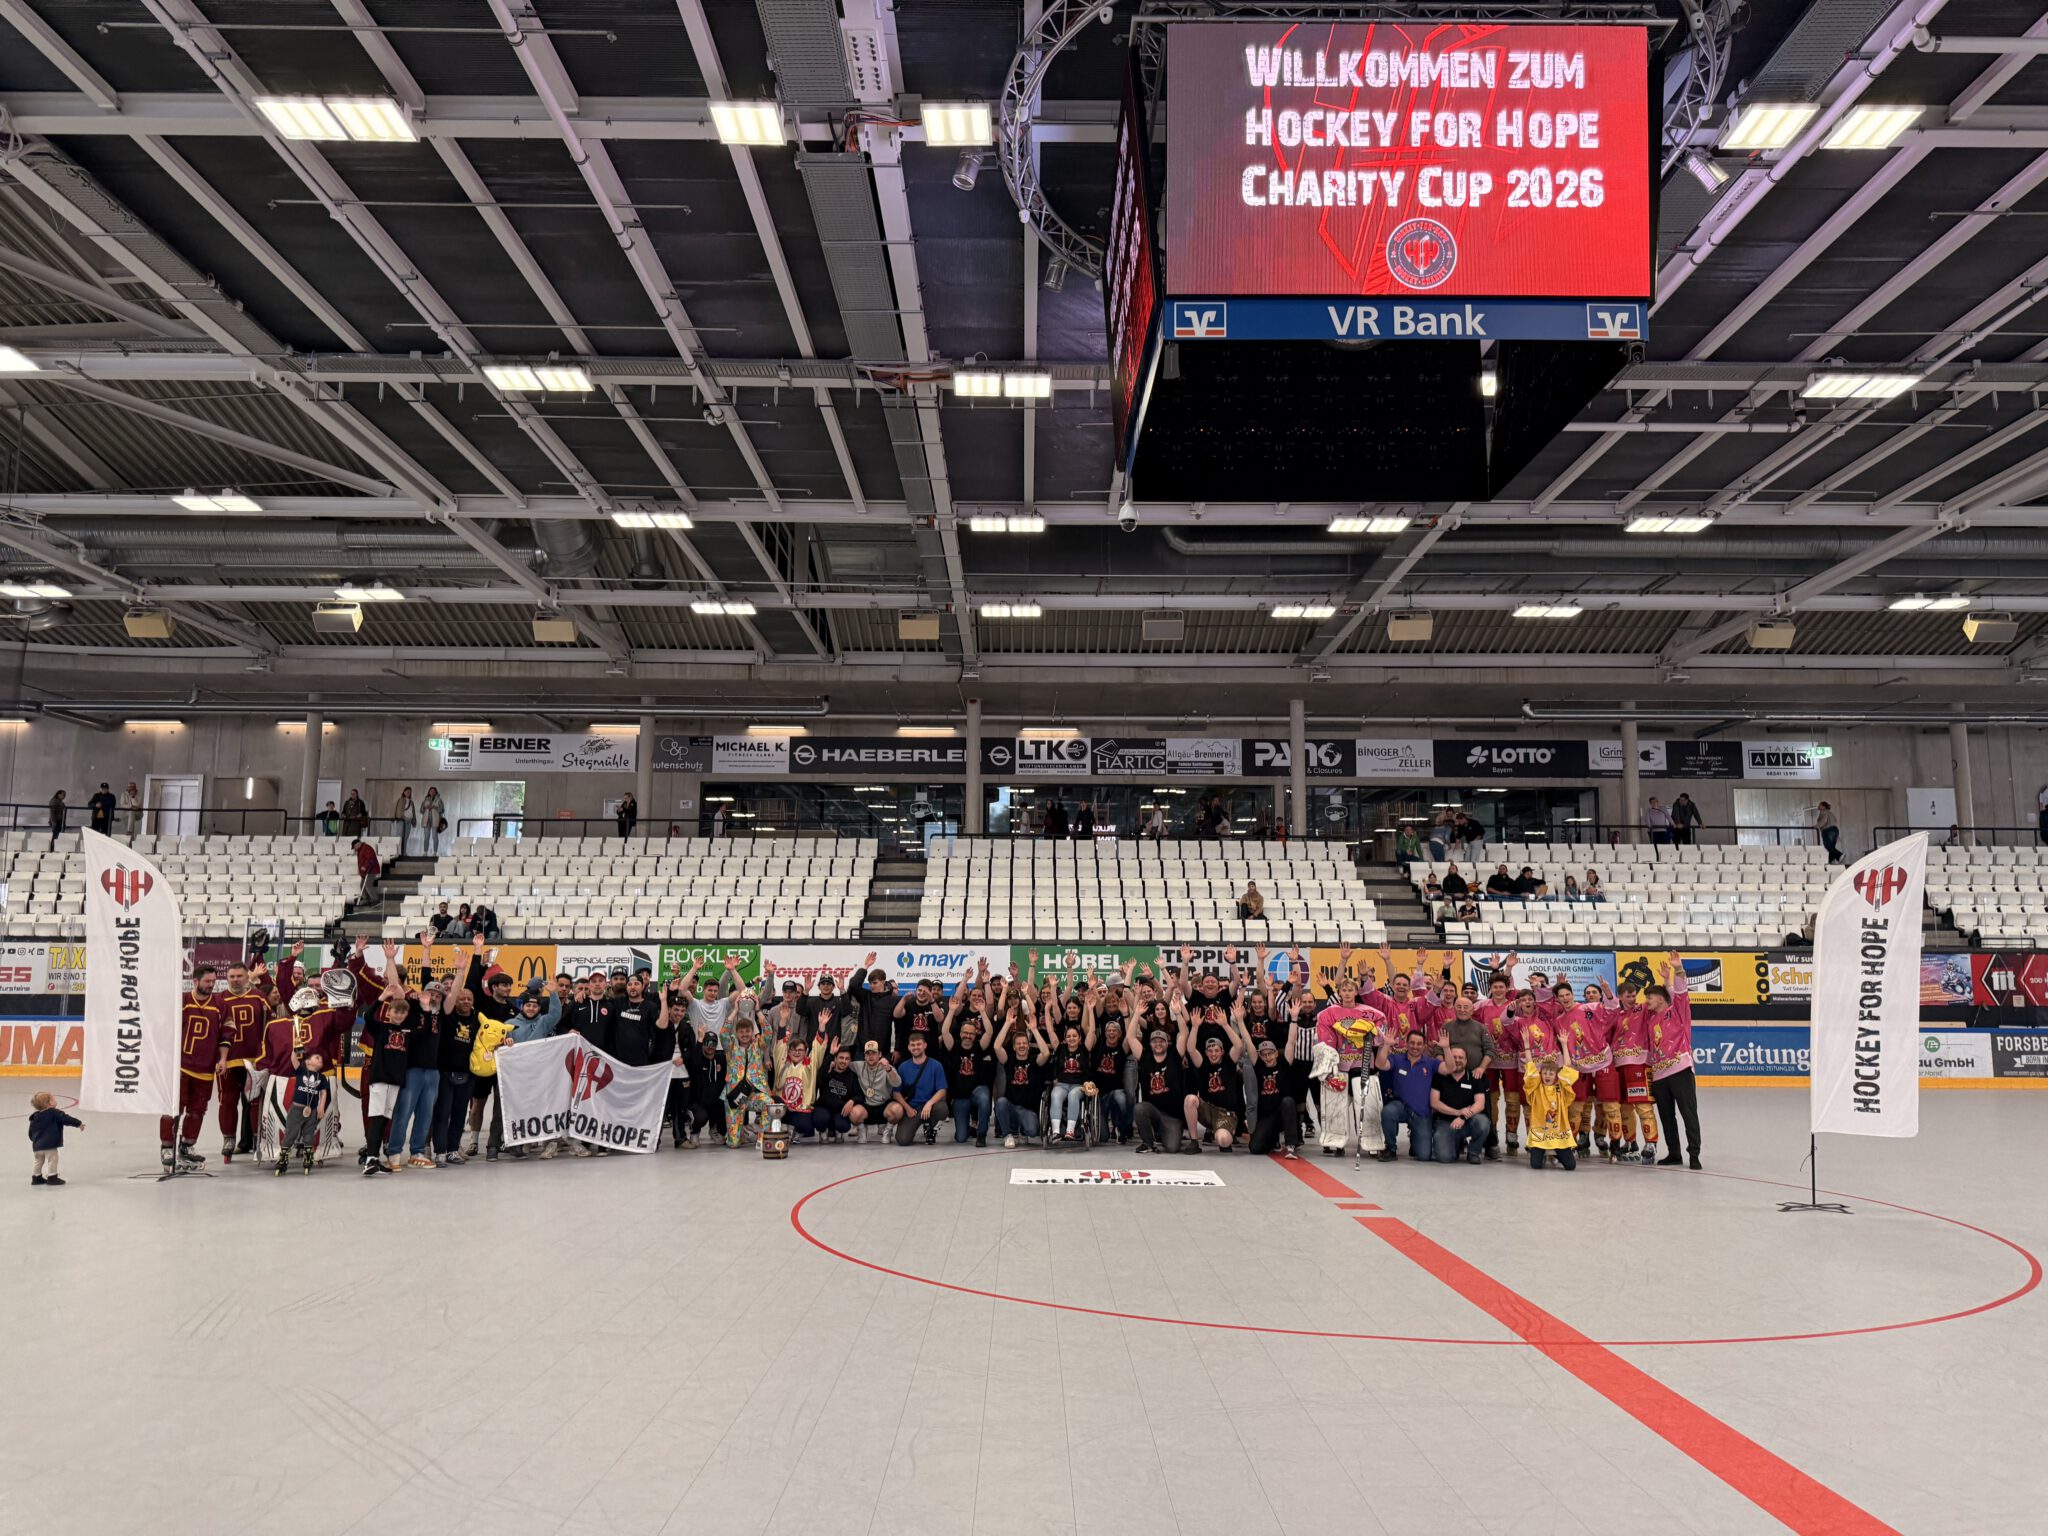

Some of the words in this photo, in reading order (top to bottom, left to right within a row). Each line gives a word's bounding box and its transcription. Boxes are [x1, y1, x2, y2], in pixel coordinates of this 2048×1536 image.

[1245, 46, 1495, 89] WILLKOMMEN
[1508, 51, 1585, 90] ZUM
[1245, 108, 1399, 149] HOCKEY
[1411, 110, 1483, 149] FOR
[1496, 110, 1600, 150] HOPE
[1242, 167, 1406, 208] CHARITY
[1417, 168, 1493, 209] CUP
[1507, 169, 1605, 209] 2026
[1327, 305, 1381, 336] VR
[1393, 303, 1487, 336] Bank
[479, 737, 551, 751] EBNER
[715, 742, 770, 752] MICHAEL
[775, 742, 788, 752] K.
[1018, 740, 1067, 760] LTK
[515, 758, 554, 766] Unterthingau
[561, 752, 630, 770] Stegmühle
[822, 748, 967, 762] HAEBERLE
[1097, 755, 1165, 769] HARTIG
[1167, 750, 1232, 760] Allgäu-Brennerei
[1491, 748, 1552, 764] LOTTO
[1753, 754, 1810, 765] AVAN
[1398, 759, 1432, 768] ZELLER
[1492, 766, 1513, 774] Bayern
[1861, 917, 1890, 975] HOPE
[407, 956, 445, 965] Aueit
[562, 956, 630, 964] SPENGLEREI
[918, 953, 969, 970] mayr
[1043, 949, 1121, 970] HÖBEL
[1162, 949, 1249, 963] TPPIH
[1550, 957, 1606, 965] LANDMETZGEREI
[1785, 954, 1799, 962] Wir
[48, 972, 61, 980] WIR
[1573, 965, 1594, 973] GMBH
[1858, 975, 1884, 1022] FOR
[231, 1003, 255, 1043] P
[183, 1014, 210, 1055] P
[1692, 1045, 1716, 1064] er
[1719, 1042, 1812, 1071] Zeitung
[1918, 1059, 1935, 1068] au
[1935, 1058, 1975, 1068] GmbH
[1853, 1026, 1882, 1114] HOCKEY
[511, 1110, 570, 1141] HOCK
[600, 1121, 651, 1149] HOPE
